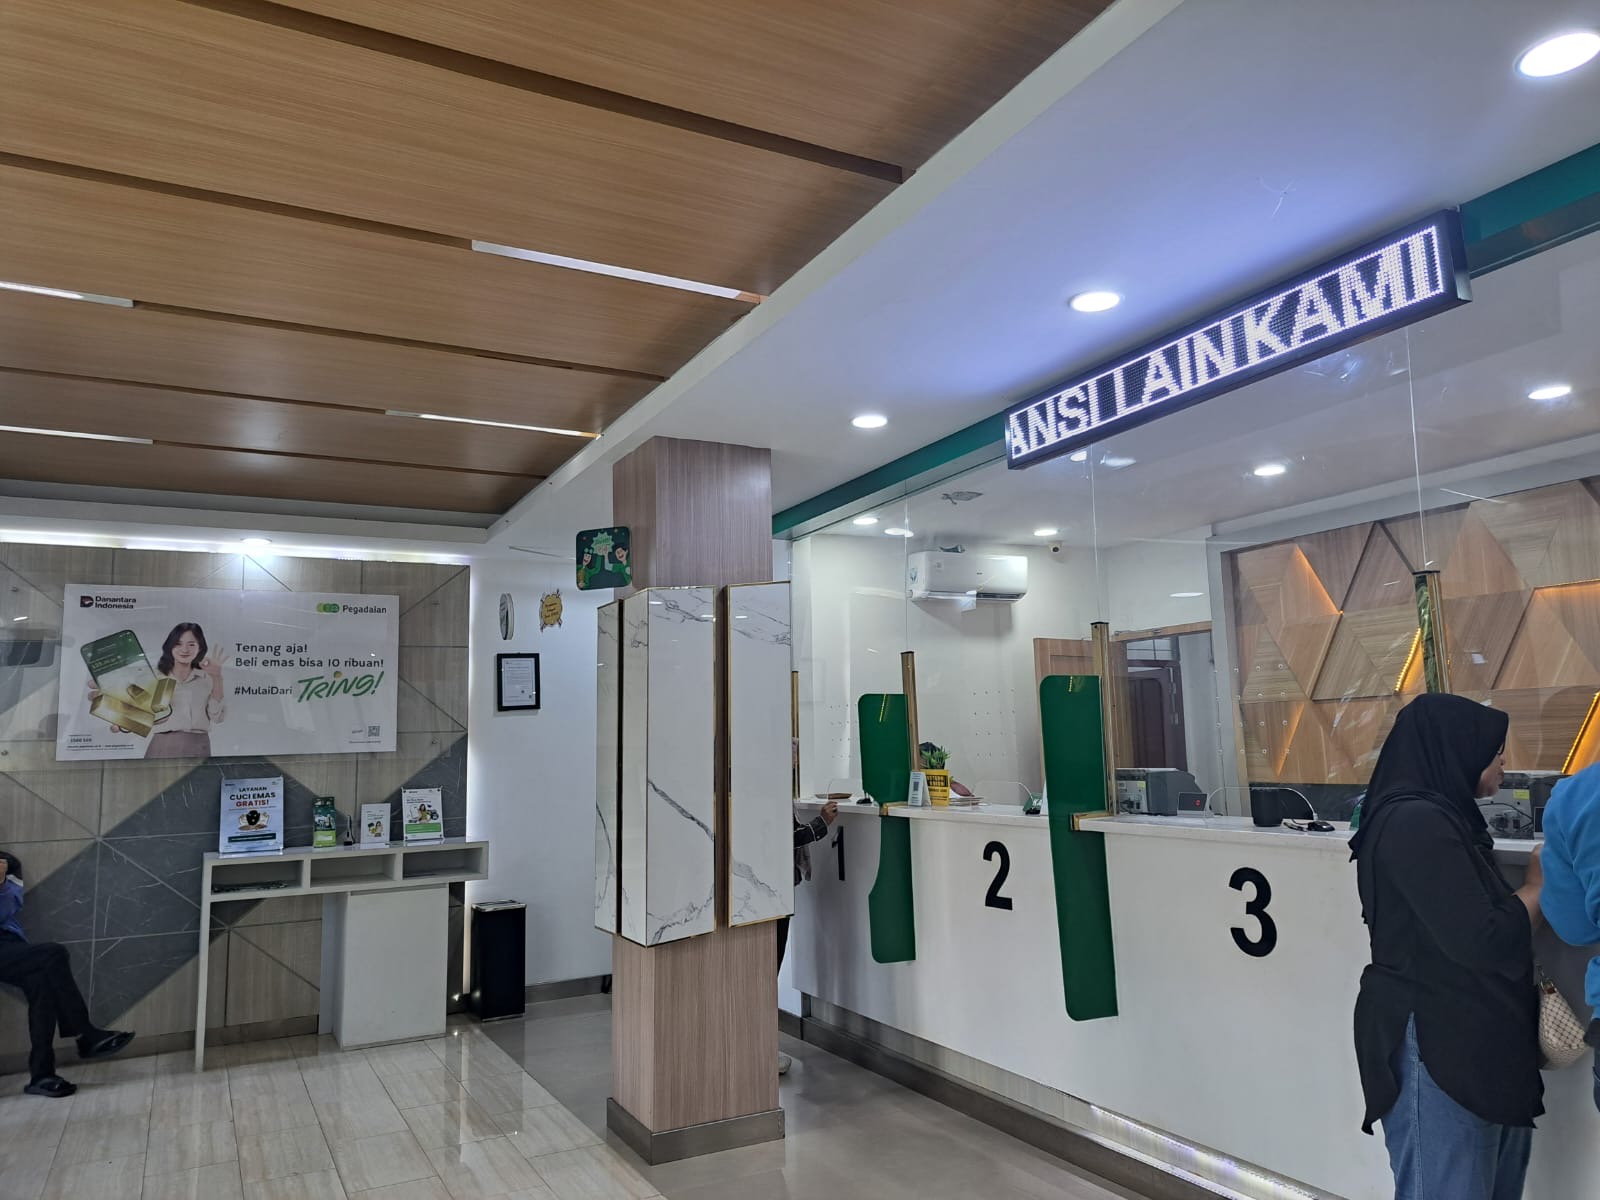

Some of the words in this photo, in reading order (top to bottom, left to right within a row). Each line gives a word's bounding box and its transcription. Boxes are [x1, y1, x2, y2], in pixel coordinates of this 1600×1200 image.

[1113, 320, 1237, 416] LAIN
[1243, 235, 1430, 364] KAMI
[95, 595, 137, 603] Danantara
[342, 604, 387, 614] Pegadaian
[235, 642, 281, 656] Tenang
[286, 643, 308, 655] aja!
[235, 657, 258, 667] Beli
[262, 659, 295, 667] emas
[299, 657, 323, 667] bisa
[344, 658, 384, 668] ribuan!
[234, 685, 293, 695] #MulaiDari
[229, 793, 251, 801] CUCI
[252, 792, 276, 800] EMAS
[235, 799, 269, 808] GRATIS!
[831, 826, 845, 881] 1
[983, 841, 1013, 911] 2
[1229, 867, 1277, 957] 3
